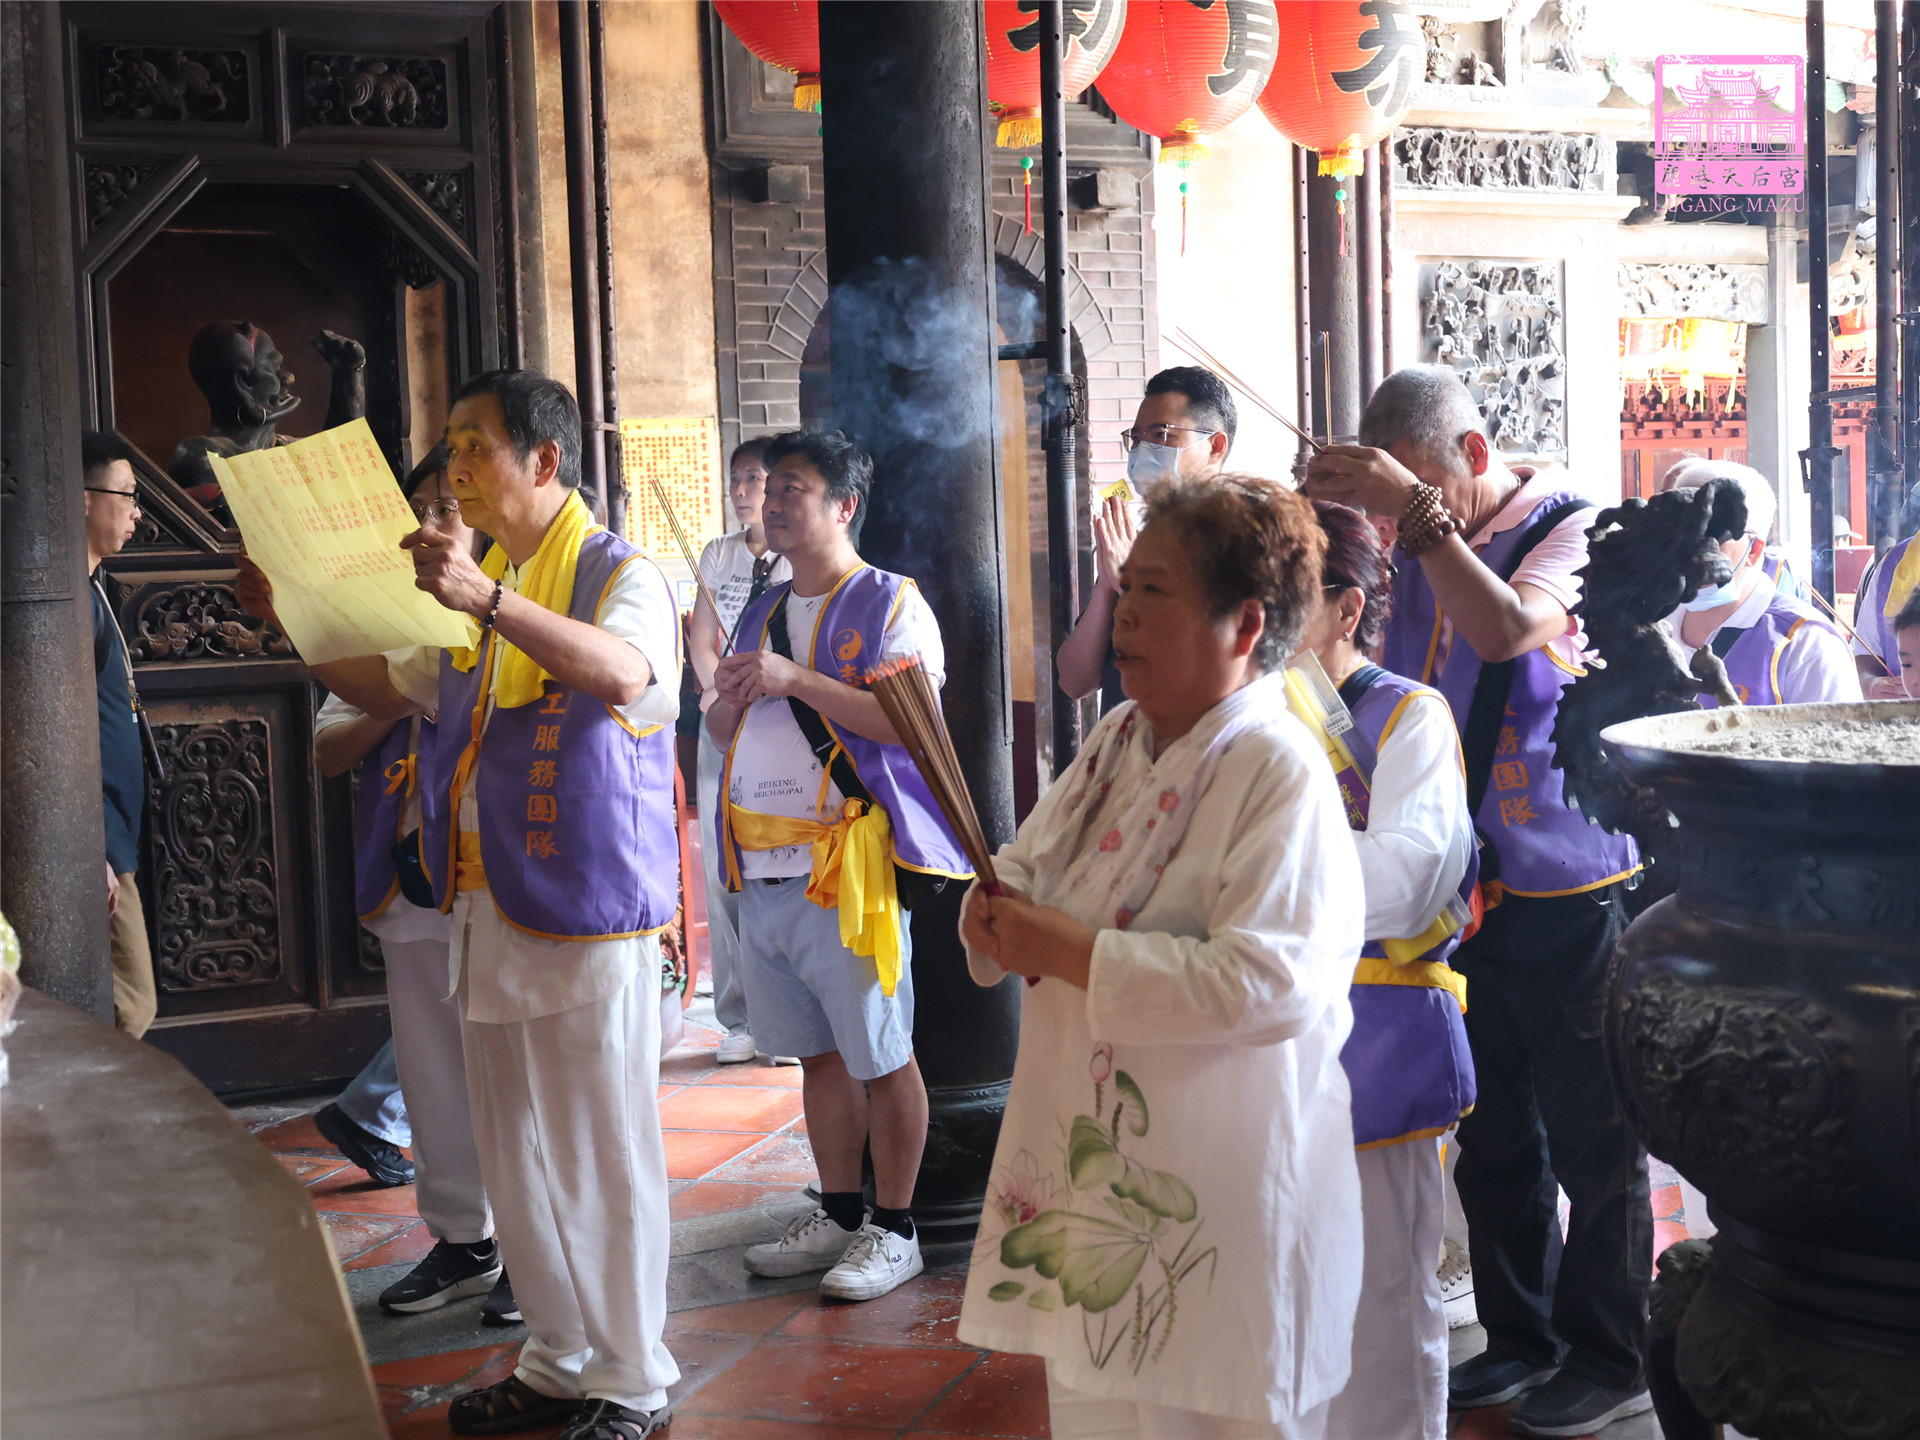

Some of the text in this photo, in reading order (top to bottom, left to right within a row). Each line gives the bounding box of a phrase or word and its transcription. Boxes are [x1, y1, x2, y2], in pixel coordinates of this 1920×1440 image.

[526, 692, 567, 859] 工服務團隊
[753, 786, 803, 799] BEICHAOPAI
[758, 778, 797, 790] BEIKING
[1493, 701, 1540, 828] 務團隊
